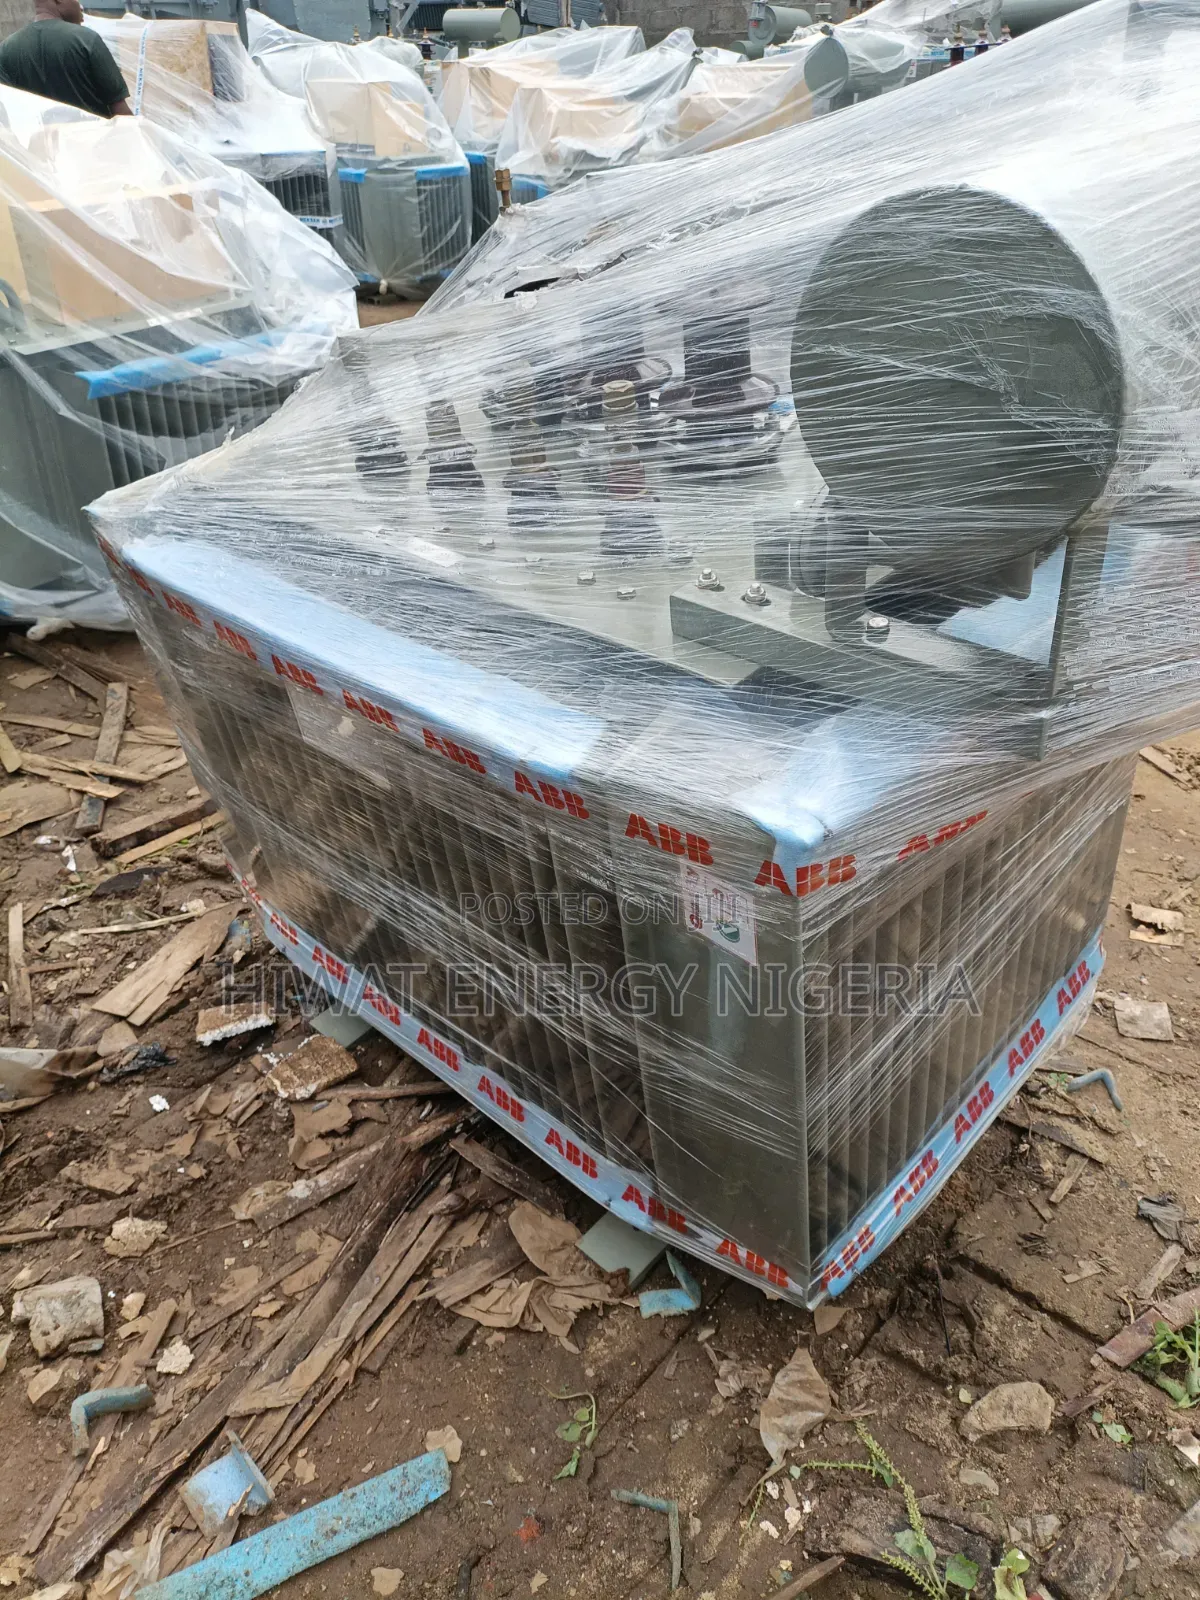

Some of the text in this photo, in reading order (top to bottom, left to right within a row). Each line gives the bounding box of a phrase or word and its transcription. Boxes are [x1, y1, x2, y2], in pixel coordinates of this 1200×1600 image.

[342, 689, 400, 732] ABB
[421, 728, 487, 774] ABB
[514, 771, 591, 820] ABB
[624, 812, 715, 866] ABB
[753, 853, 858, 899] ABB
[312, 945, 349, 985] ABB
[361, 984, 401, 1027] ABB
[416, 1027, 460, 1073] ABB
[476, 1075, 526, 1123] ABB
[544, 1127, 599, 1180] ABB
[621, 1184, 688, 1235] ABB
[716, 1238, 789, 1288] ABB
[820, 1224, 877, 1292] ABB
[893, 1148, 940, 1217] ABB
[953, 1080, 995, 1145] ABB
[1007, 1018, 1046, 1078] ABB
[1056, 960, 1091, 1017] ABB
